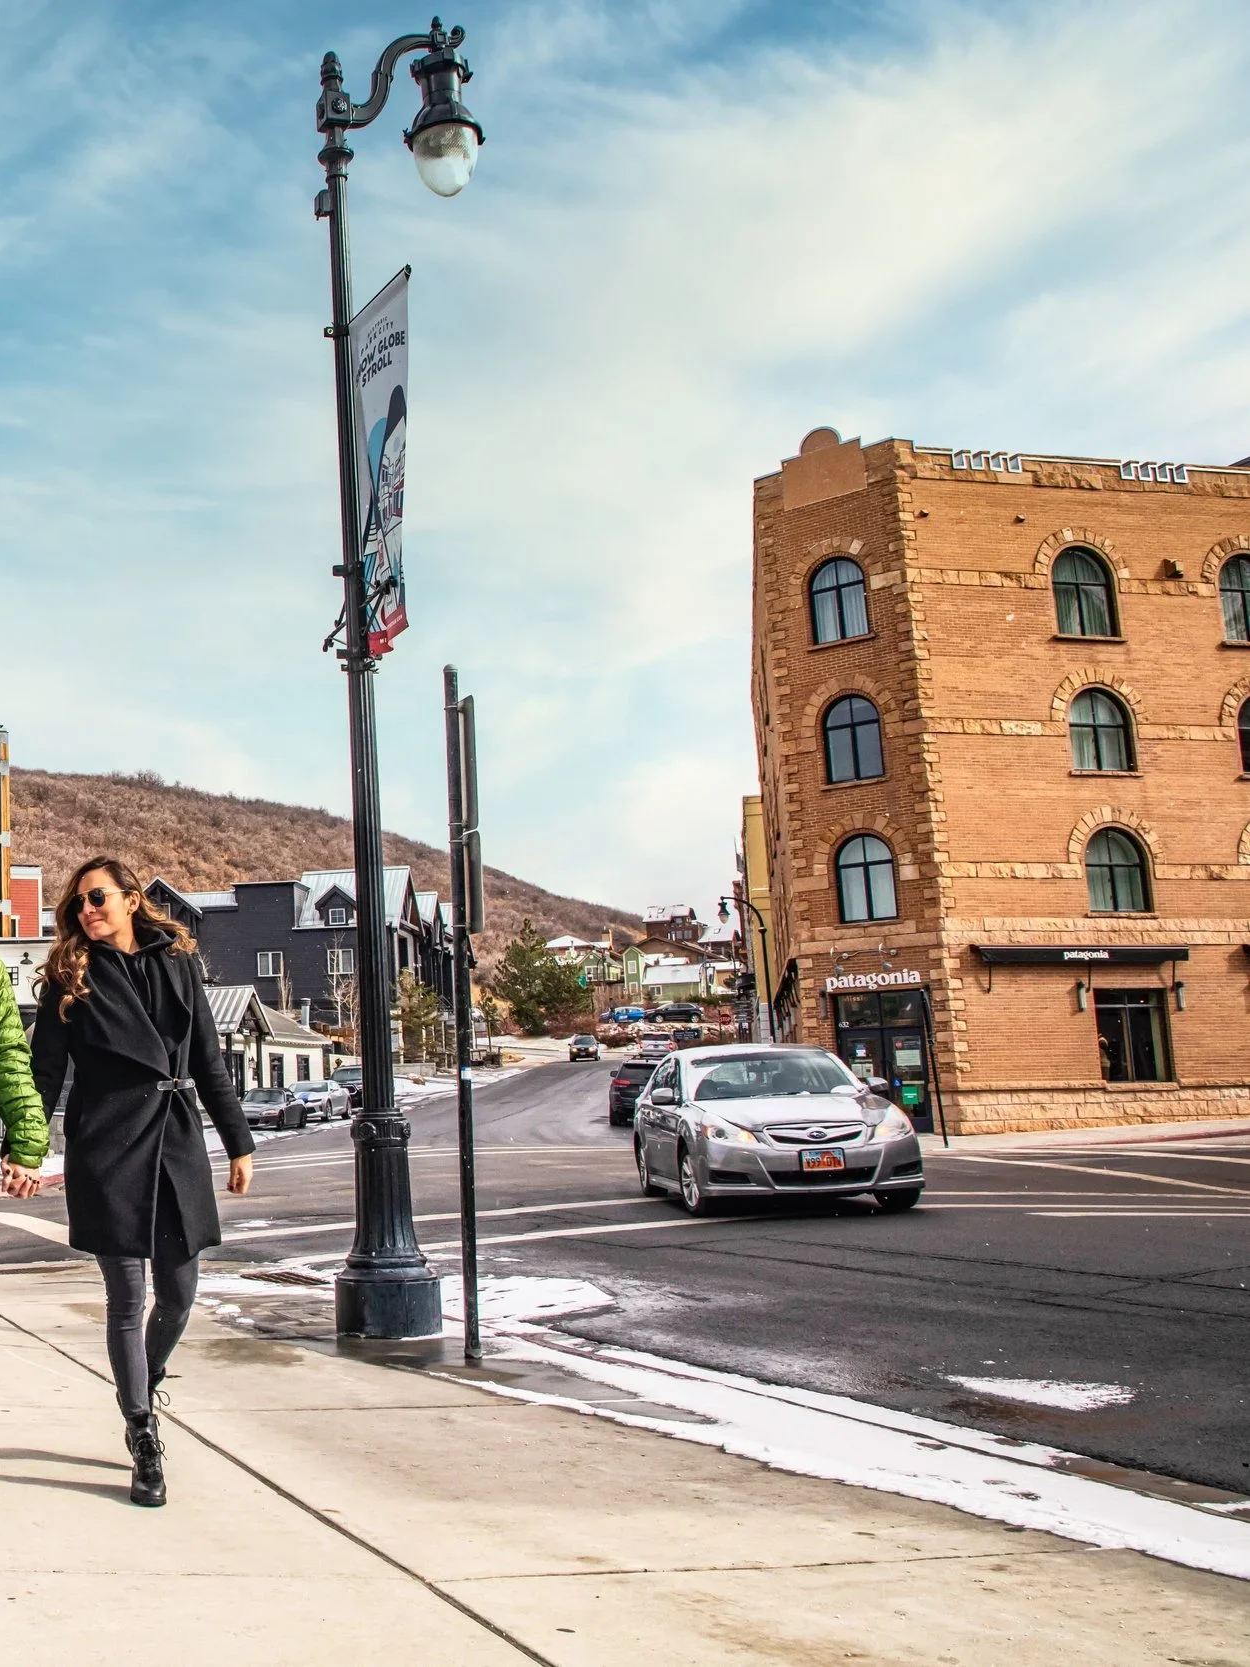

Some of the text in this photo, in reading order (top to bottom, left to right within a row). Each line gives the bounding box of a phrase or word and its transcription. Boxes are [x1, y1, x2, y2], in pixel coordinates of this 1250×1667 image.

[378, 320, 394, 335] CITY
[378, 330, 406, 355] GLOBE
[362, 351, 393, 388] STROLL
[1063, 950, 1110, 961] patagonia
[825, 968, 921, 993] patagonia
